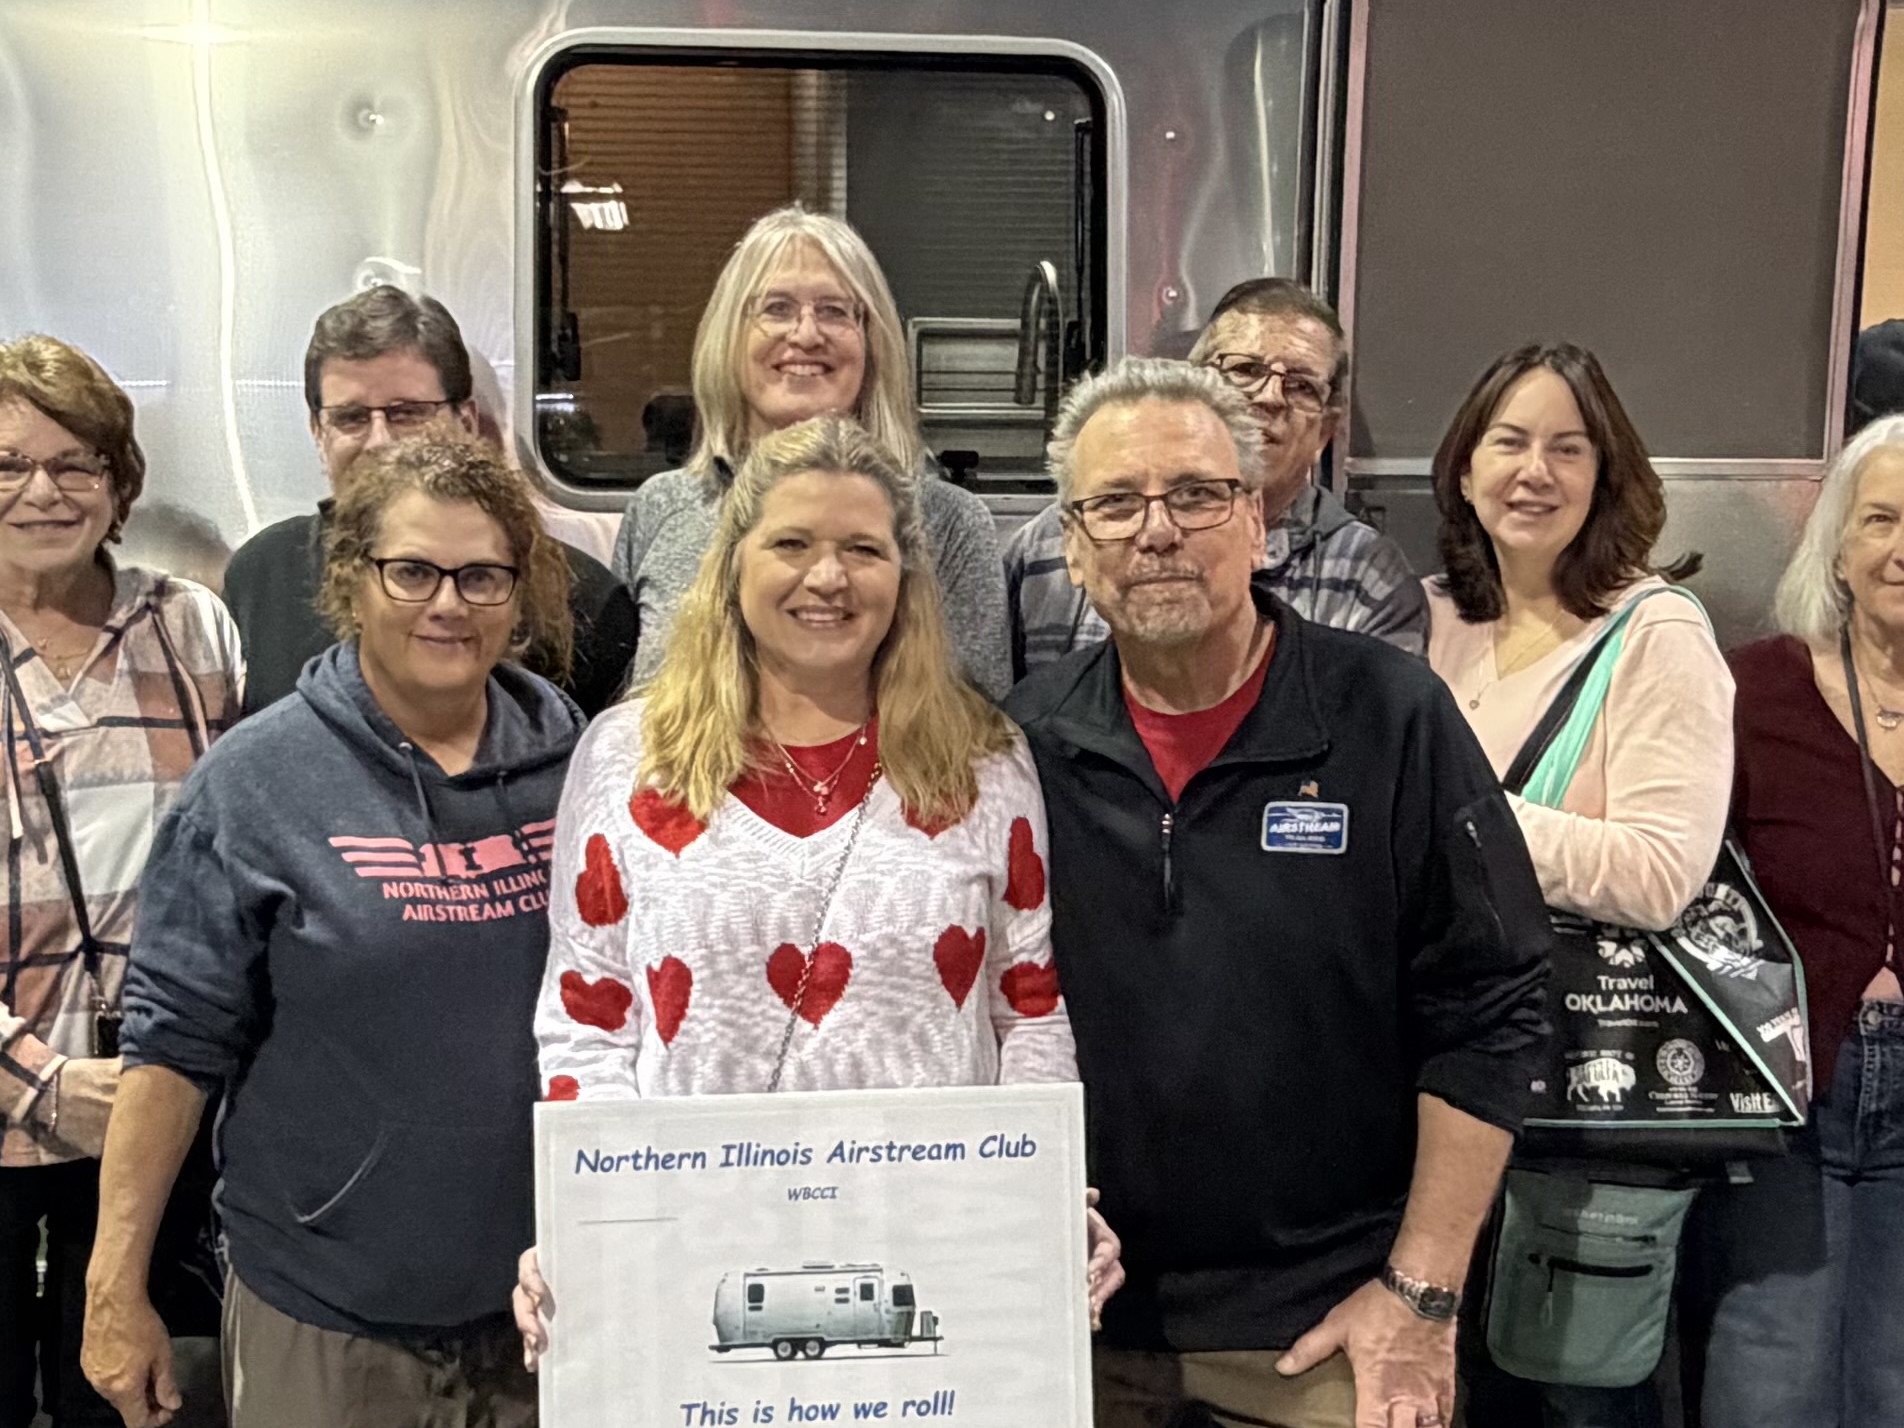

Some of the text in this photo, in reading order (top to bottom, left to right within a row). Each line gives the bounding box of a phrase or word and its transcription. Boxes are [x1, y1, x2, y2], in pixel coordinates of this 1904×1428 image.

[1269, 821, 1341, 834] AIRSTREAM
[382, 869, 548, 901] NORTHERN ILLIN
[402, 889, 551, 922] AIRSTREAM CLU
[1597, 974, 1654, 991] Travel
[1565, 993, 1688, 1015] OKLAHOMA
[575, 1134, 1037, 1174] Northern Illinois Airstream Club
[787, 1184, 839, 1202] WBCCI
[680, 1389, 955, 1427] This is how we roll!
